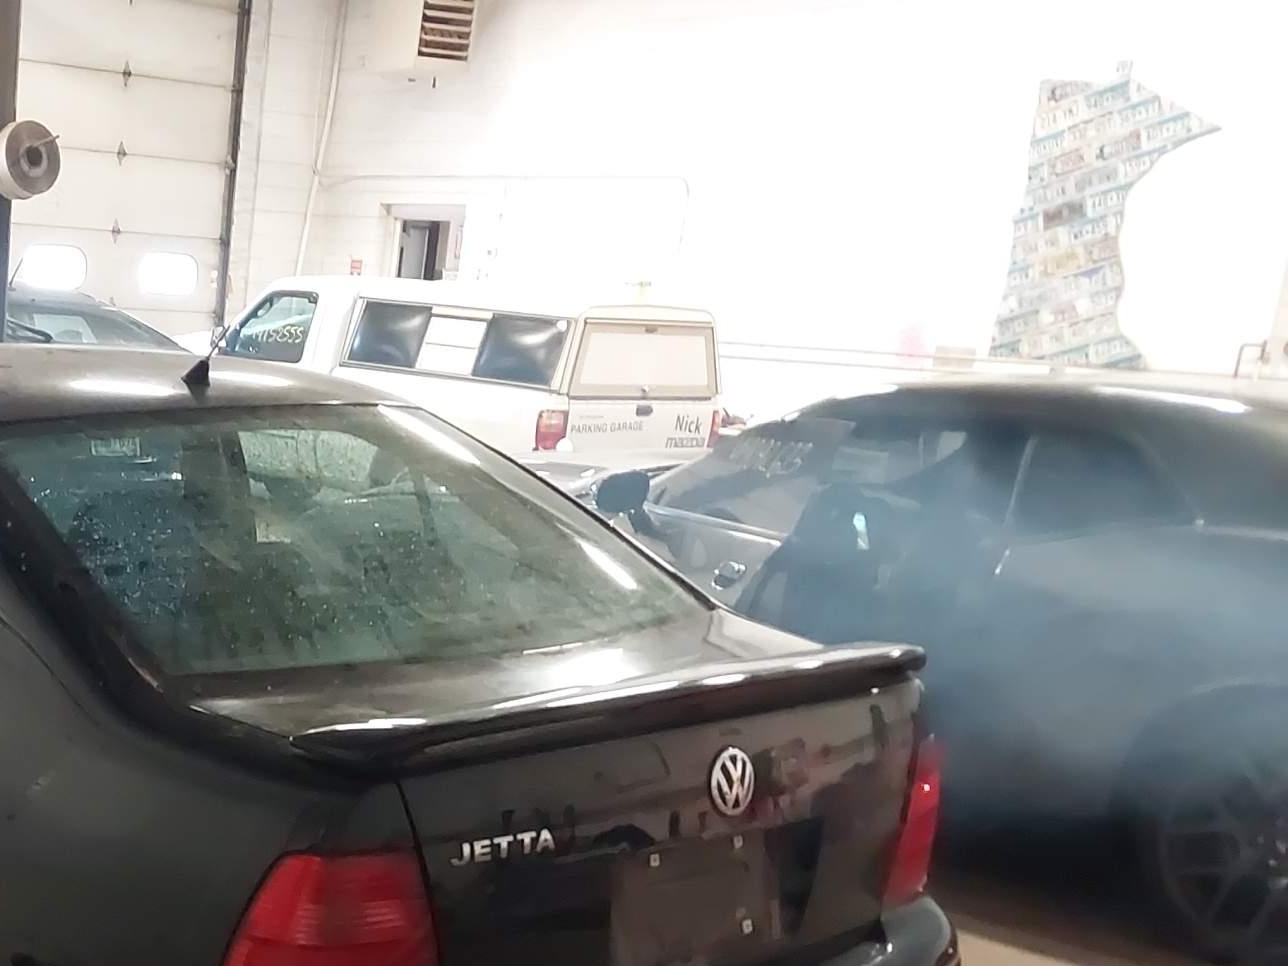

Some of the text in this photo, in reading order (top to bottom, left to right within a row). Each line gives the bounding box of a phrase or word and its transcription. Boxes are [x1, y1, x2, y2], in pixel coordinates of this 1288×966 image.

[571, 420, 644, 433] PARKING GARAGE
[674, 414, 702, 434] Nick
[450, 828, 556, 866] JETTA
